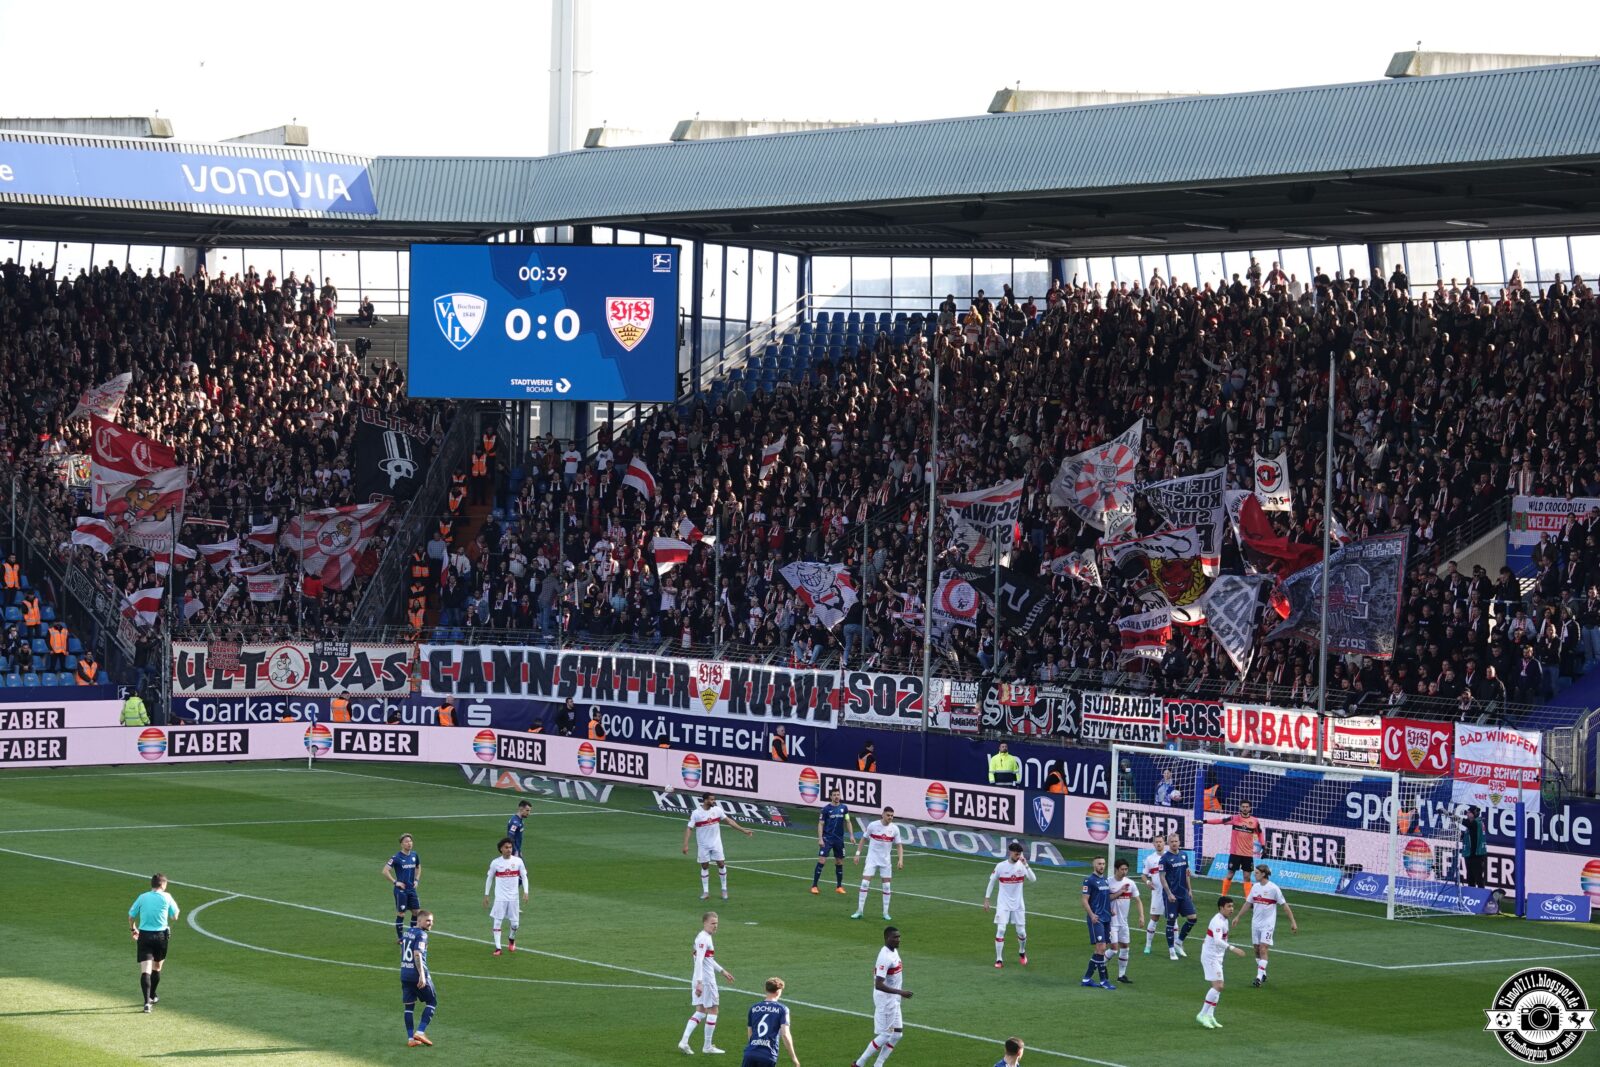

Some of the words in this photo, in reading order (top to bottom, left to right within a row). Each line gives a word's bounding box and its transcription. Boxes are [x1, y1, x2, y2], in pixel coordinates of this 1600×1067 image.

[518, 266, 568, 281] 00:39
[504, 308, 580, 342] 0:0
[511, 378, 554, 386] STADTWERKE
[360, 407, 430, 445] ULTRAS
[1544, 502, 1587, 513] CROCODILES
[429, 650, 690, 709] CANNSTATTER
[728, 666, 835, 723] KURVE
[951, 681, 979, 691] ULTRAS
[185, 697, 320, 724] Sparkasse
[331, 698, 439, 725] ochum
[1083, 694, 1161, 718] SÜDBANDE
[0, 711, 59, 729] FABER
[1083, 720, 1161, 742] STUTTGART
[1226, 708, 1329, 752] URBACH
[175, 732, 242, 753] FABER
[340, 731, 412, 753] FABER
[641, 716, 806, 757] KÄLTETECHIK
[1459, 732, 1483, 746] BAD
[1485, 731, 1538, 756] WIMPFEN
[0, 740, 61, 760] FABER
[500, 737, 543, 762] FABER
[599, 751, 645, 776] FABER
[1458, 762, 1492, 778] STAUFER
[1493, 767, 1538, 783] SCHWBEN
[459, 763, 614, 803] VIACTIV
[705, 762, 754, 789] FABER
[825, 775, 877, 805] FABER
[954, 792, 1010, 822] FABER
[732, 815, 755, 824] vom
[760, 818, 787, 828] Profi
[1271, 831, 1339, 866] FABER
[1278, 869, 1337, 885] sportwetten.de
[1441, 850, 1516, 887] FAER
[1356, 881, 1377, 894] Seco
[1383, 884, 1418, 898] Eskalt
[1461, 894, 1481, 906] Tor
[1544, 900, 1574, 911] Seco
[402, 939, 413, 962] 16
[751, 1005, 780, 1014] BOCHUM
[757, 1013, 770, 1038] 6
